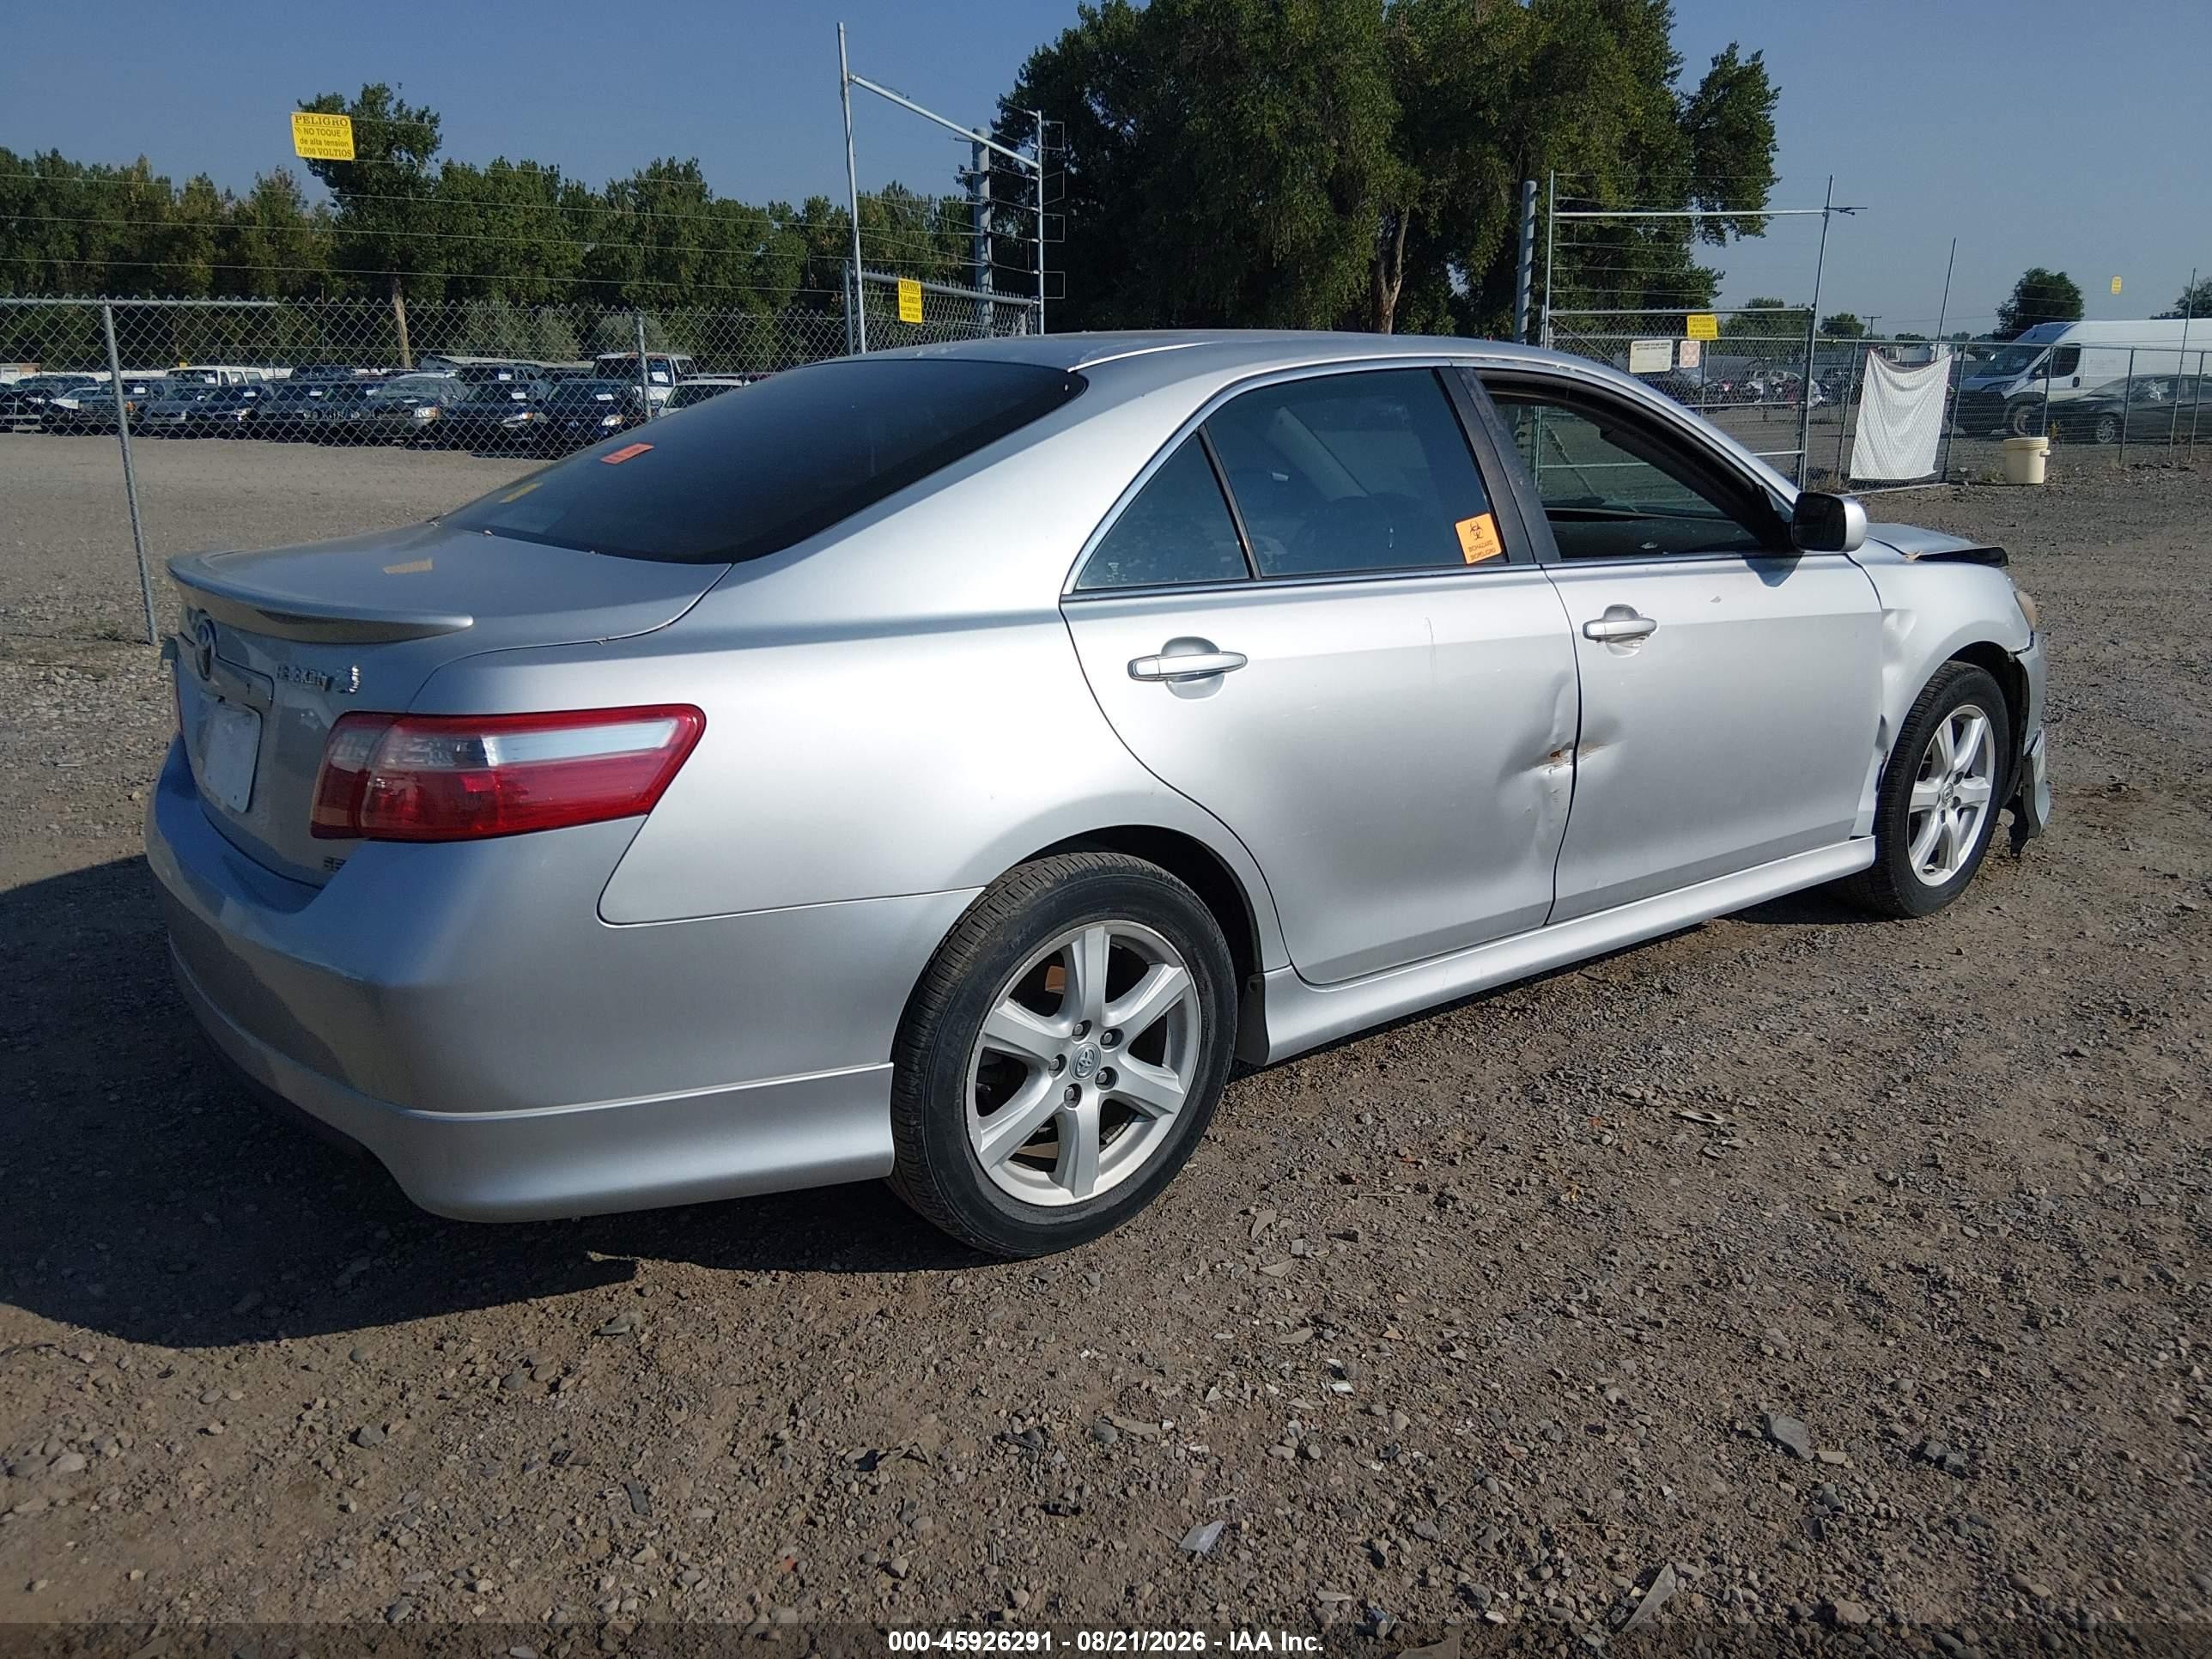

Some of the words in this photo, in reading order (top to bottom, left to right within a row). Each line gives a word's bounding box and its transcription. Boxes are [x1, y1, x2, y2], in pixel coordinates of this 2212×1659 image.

[295, 115, 348, 126] PELIGRO
[303, 127, 314, 136] NO
[315, 128, 342, 137] TOQUE
[317, 148, 352, 158] VOLTIOS
